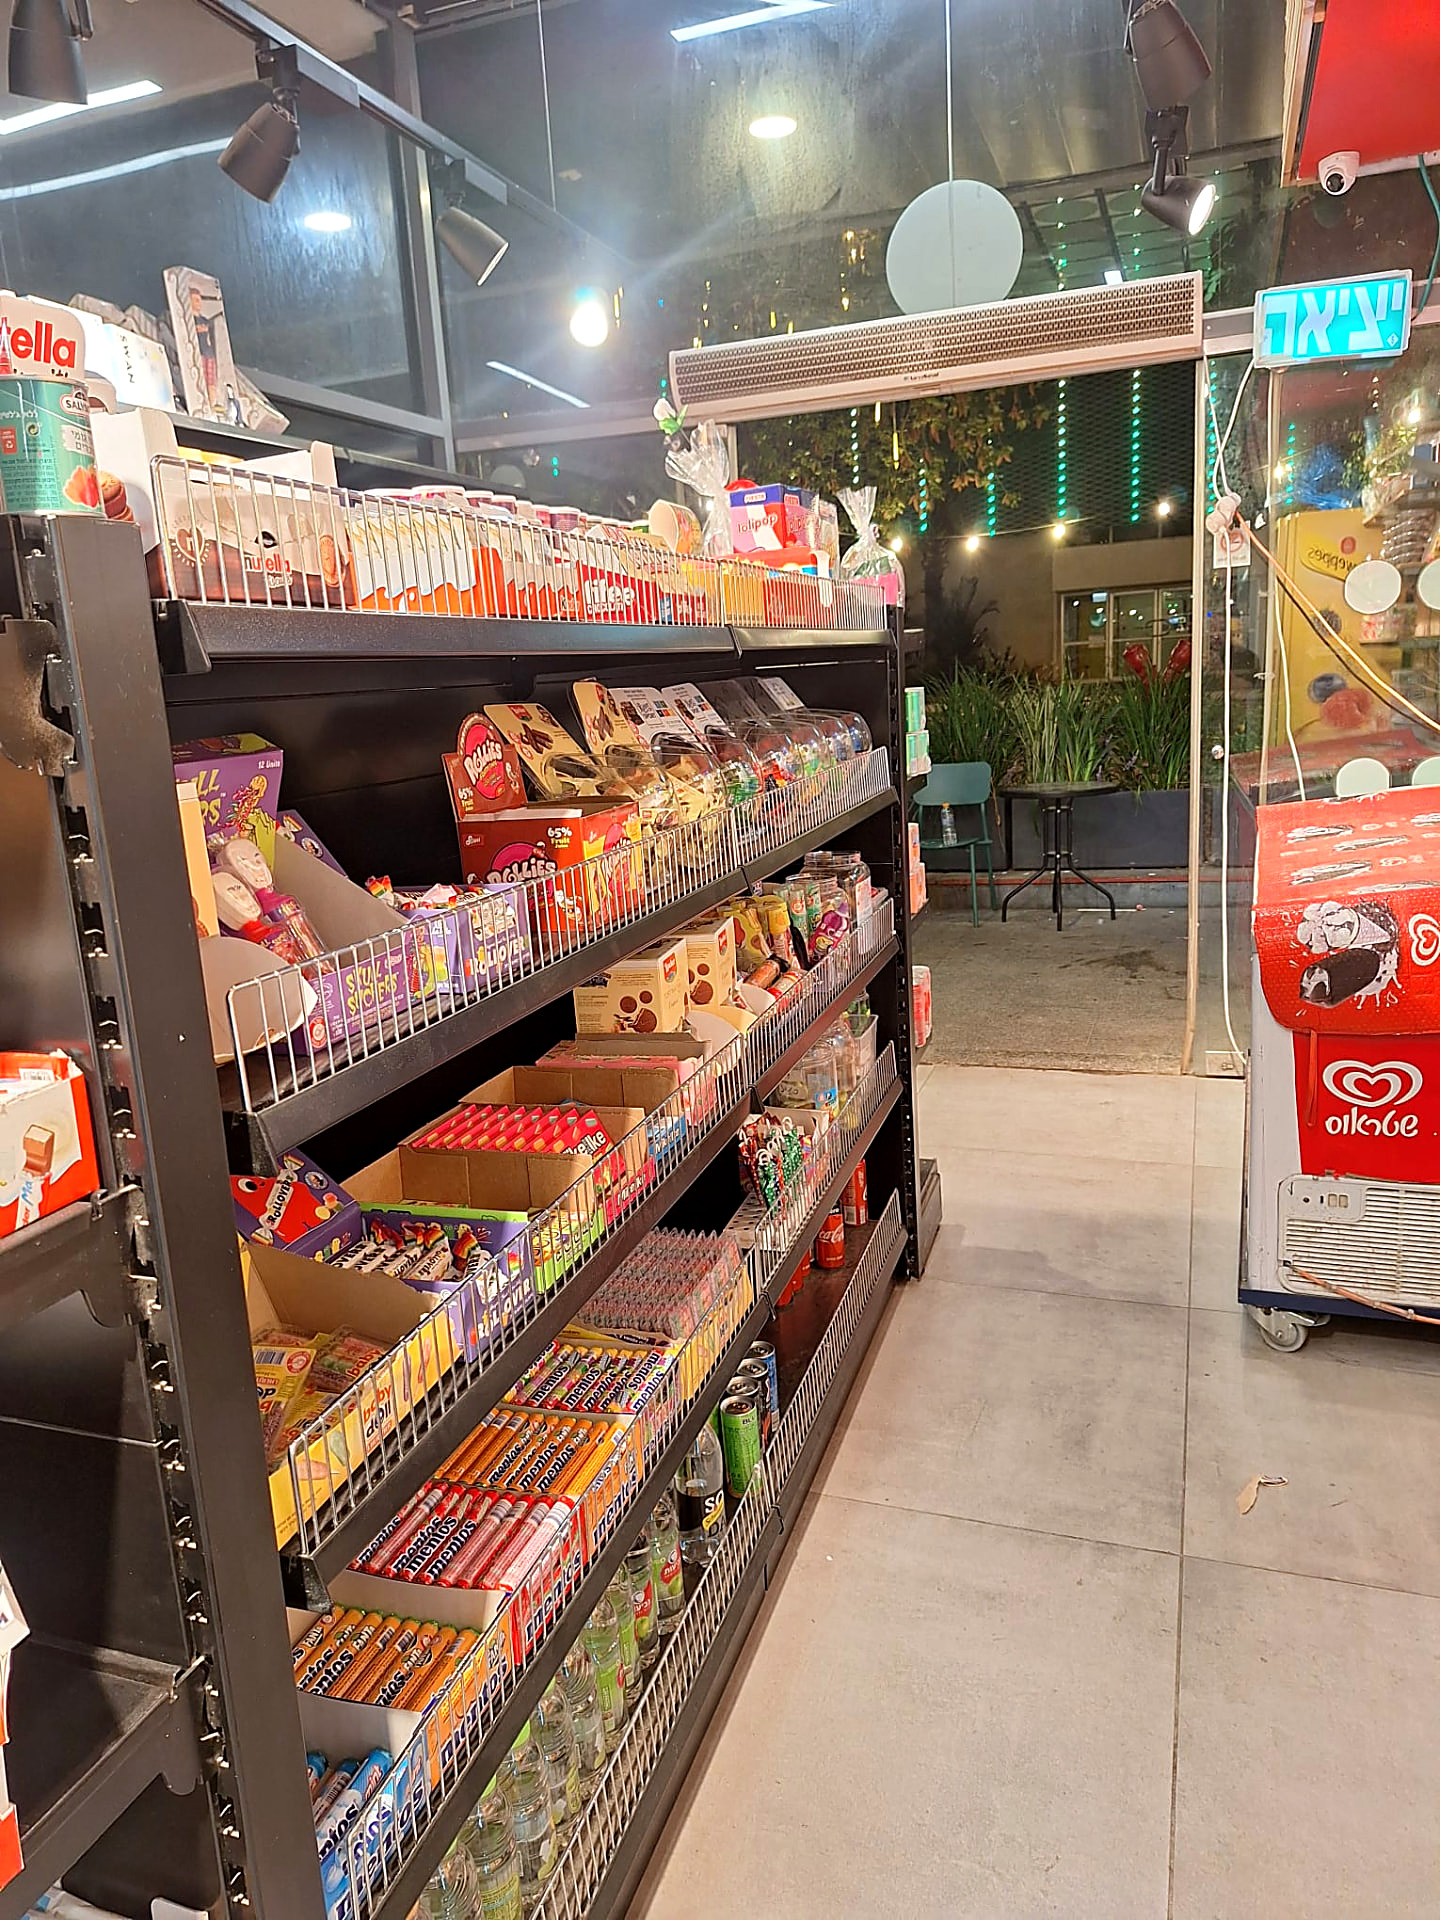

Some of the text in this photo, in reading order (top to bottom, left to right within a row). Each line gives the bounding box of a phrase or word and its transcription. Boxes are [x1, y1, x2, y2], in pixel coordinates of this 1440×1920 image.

[1261, 283, 1404, 355] יציאה
[737, 514, 777, 534] lolipop
[244, 553, 290, 573] nuella
[547, 826, 573, 838] 65%
[1325, 1106, 1419, 1138] שטראוס
[346, 1349, 381, 1378] baby
[530, 1364, 568, 1402] mentos
[628, 1352, 660, 1390] mentos
[565, 1367, 601, 1407] mentos
[583, 1370, 617, 1410] mentos
[600, 1371, 632, 1410] mentos
[632, 1371, 664, 1411] mentos
[519, 1442, 558, 1491] mentos
[536, 1443, 577, 1493] mentos
[358, 1515, 401, 1564] mentos
[392, 1516, 441, 1573] mentos
[405, 1516, 457, 1574] mentos
[426, 1520, 477, 1580] mentos
[310, 1649, 355, 1694] entos
